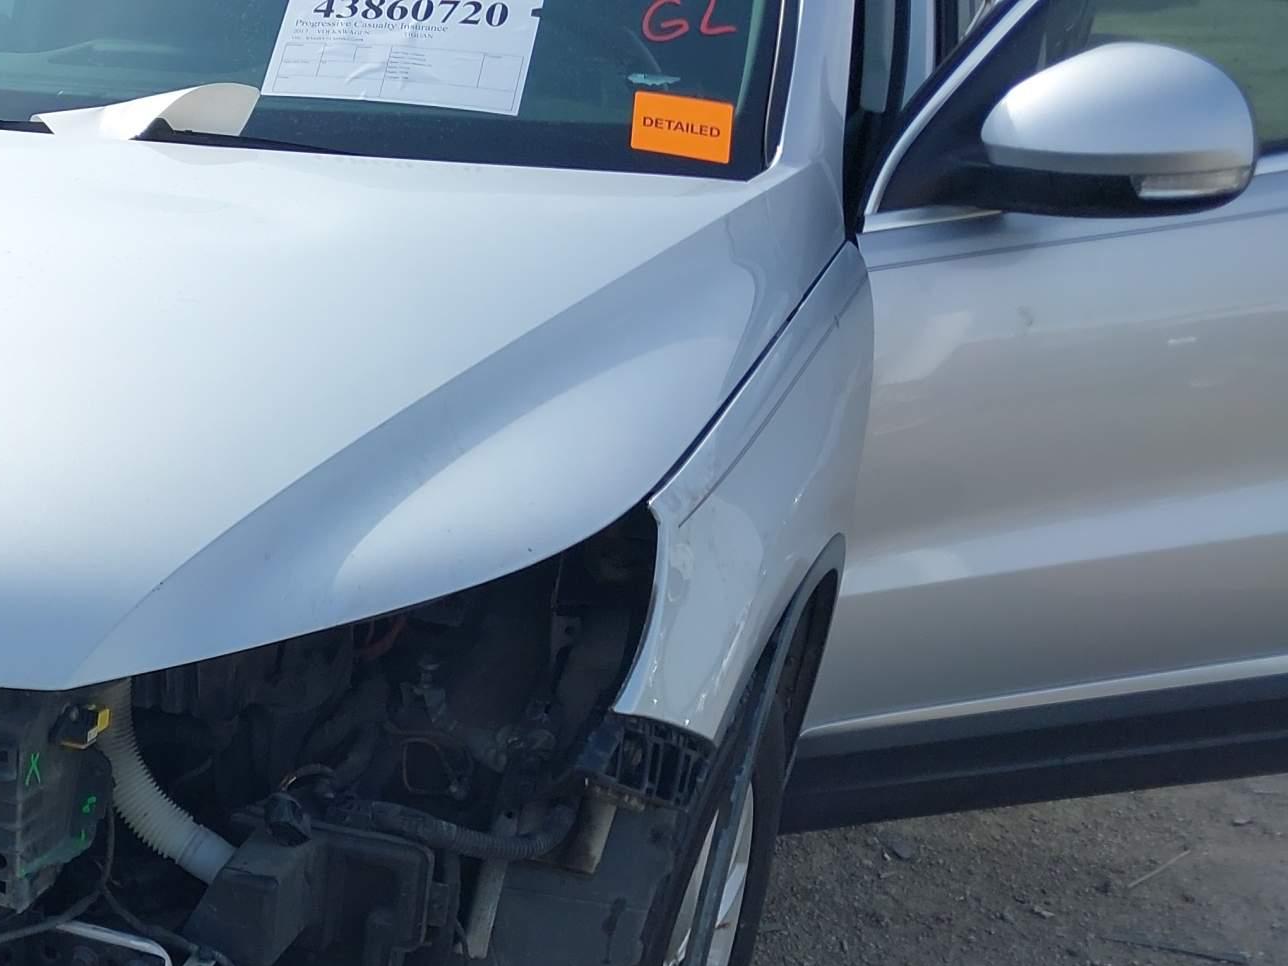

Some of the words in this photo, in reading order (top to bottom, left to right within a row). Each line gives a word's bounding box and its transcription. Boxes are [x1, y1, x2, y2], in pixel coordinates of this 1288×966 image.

[313, 0, 509, 28] 43860720
[295, 19, 352, 30] Progressive
[353, 22, 396, 31] Casualty
[400, 23, 448, 33] Insurance
[642, 116, 721, 138] DETAILED
